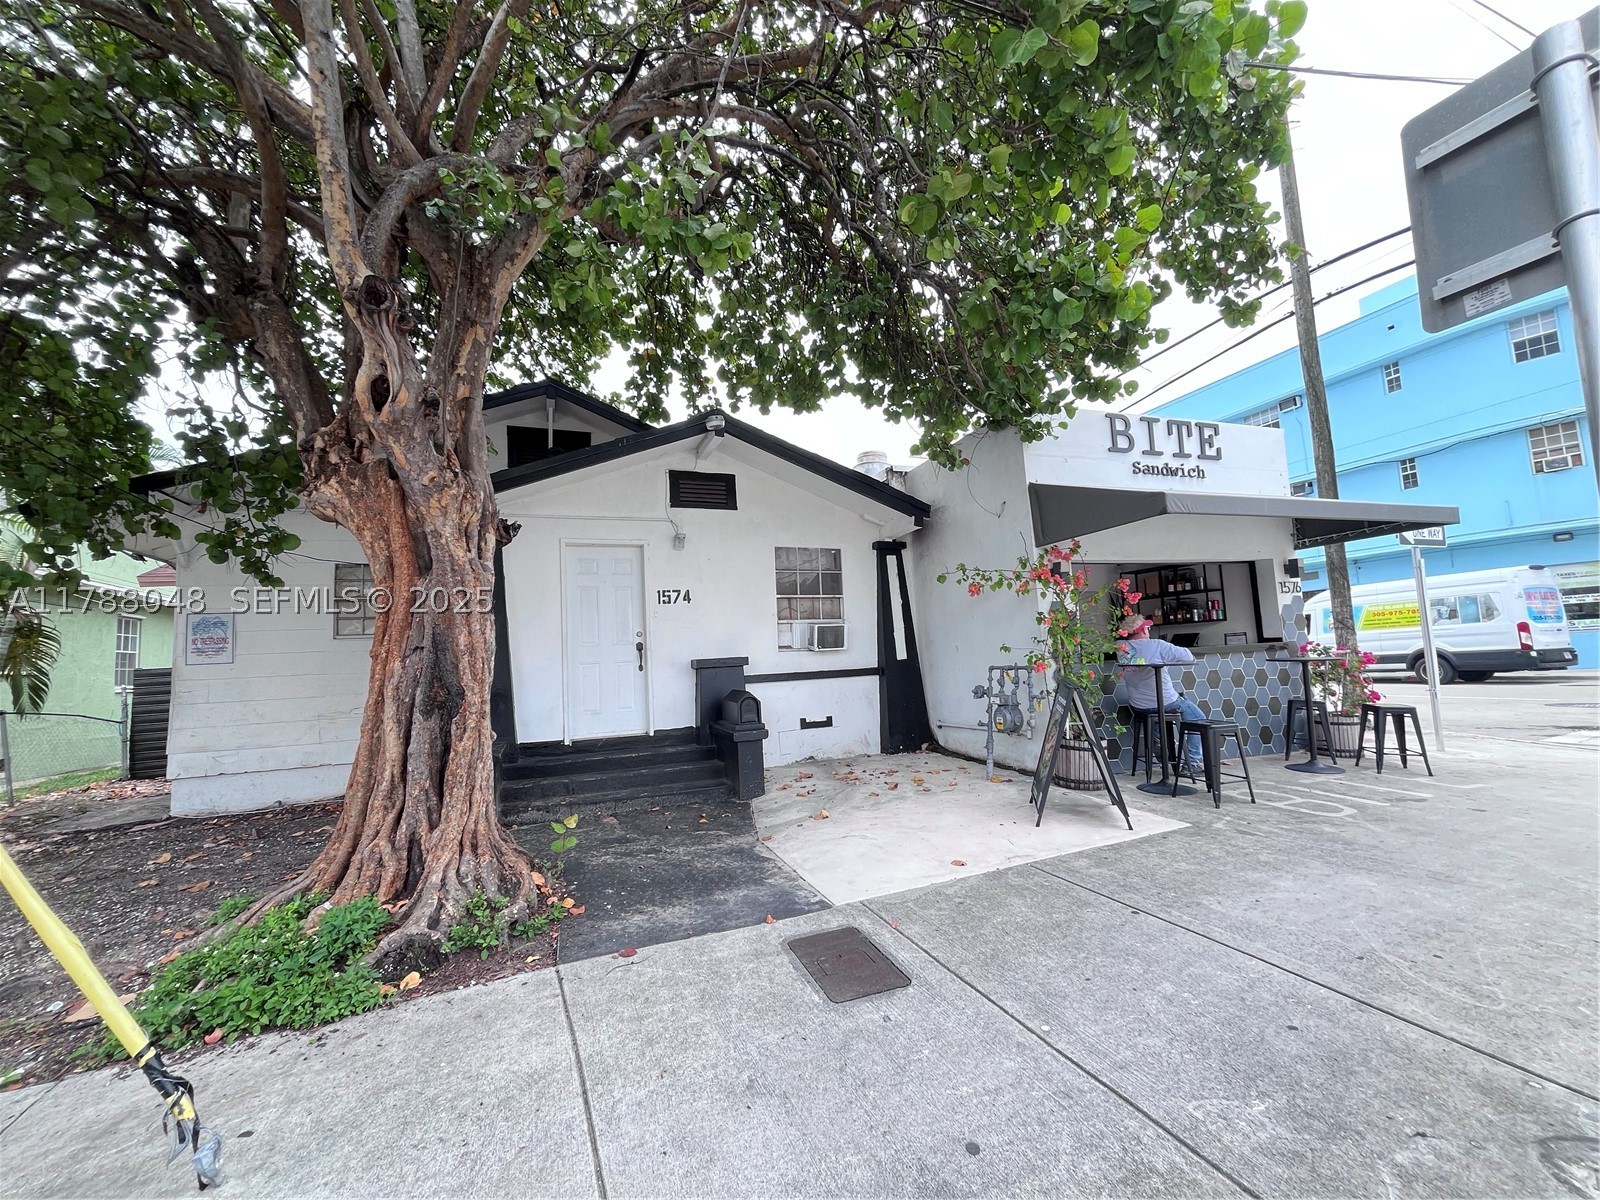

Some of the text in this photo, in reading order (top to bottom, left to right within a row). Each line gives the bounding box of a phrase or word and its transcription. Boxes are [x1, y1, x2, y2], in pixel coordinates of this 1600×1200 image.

[1105, 413, 1222, 460] BITE
[1132, 461, 1206, 479] Sandwich
[1428, 529, 1440, 538] WAY
[1278, 581, 1302, 593] 1576
[656, 589, 692, 605] 1574
[191, 637, 230, 646] NO TRESPASSING
